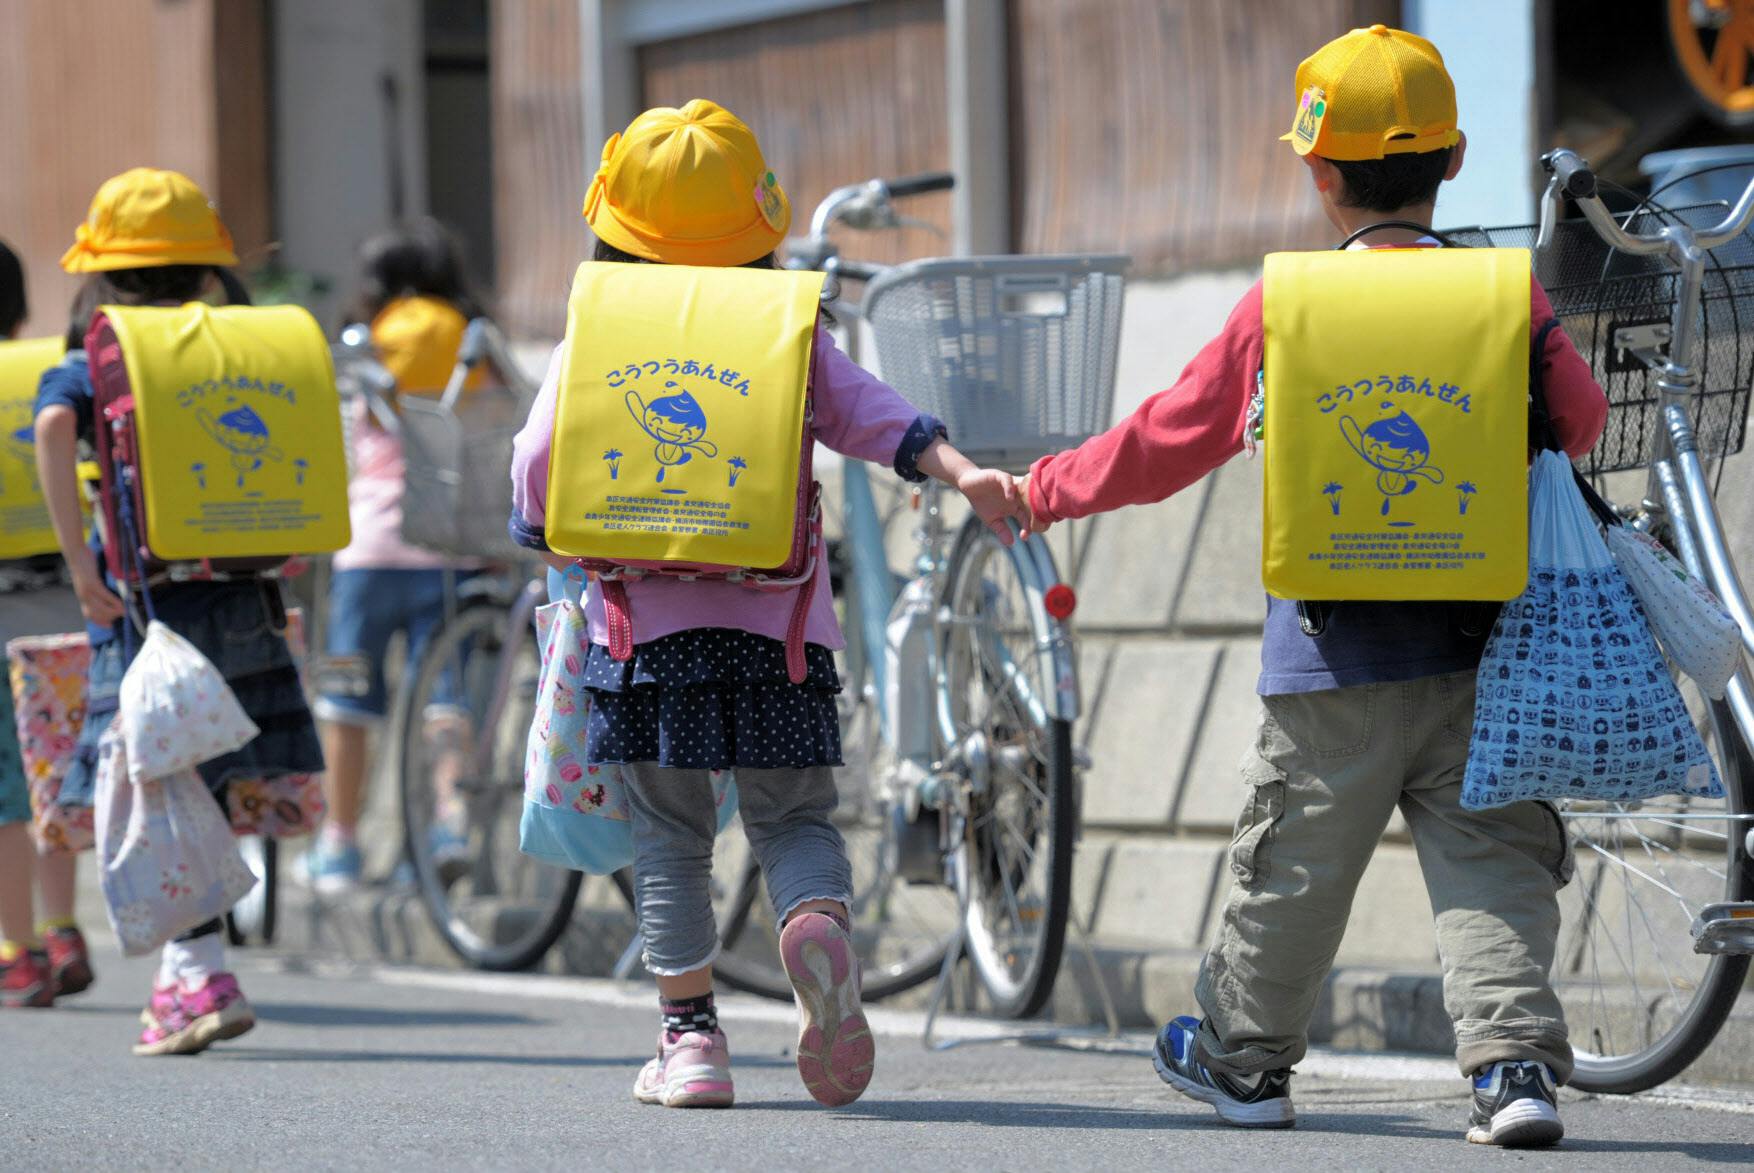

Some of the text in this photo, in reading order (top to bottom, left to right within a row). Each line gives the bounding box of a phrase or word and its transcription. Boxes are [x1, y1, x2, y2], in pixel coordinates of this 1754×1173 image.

[606, 358, 751, 397] こうつうあんぜん
[1316, 374, 1472, 414] こうつうあんぜん
